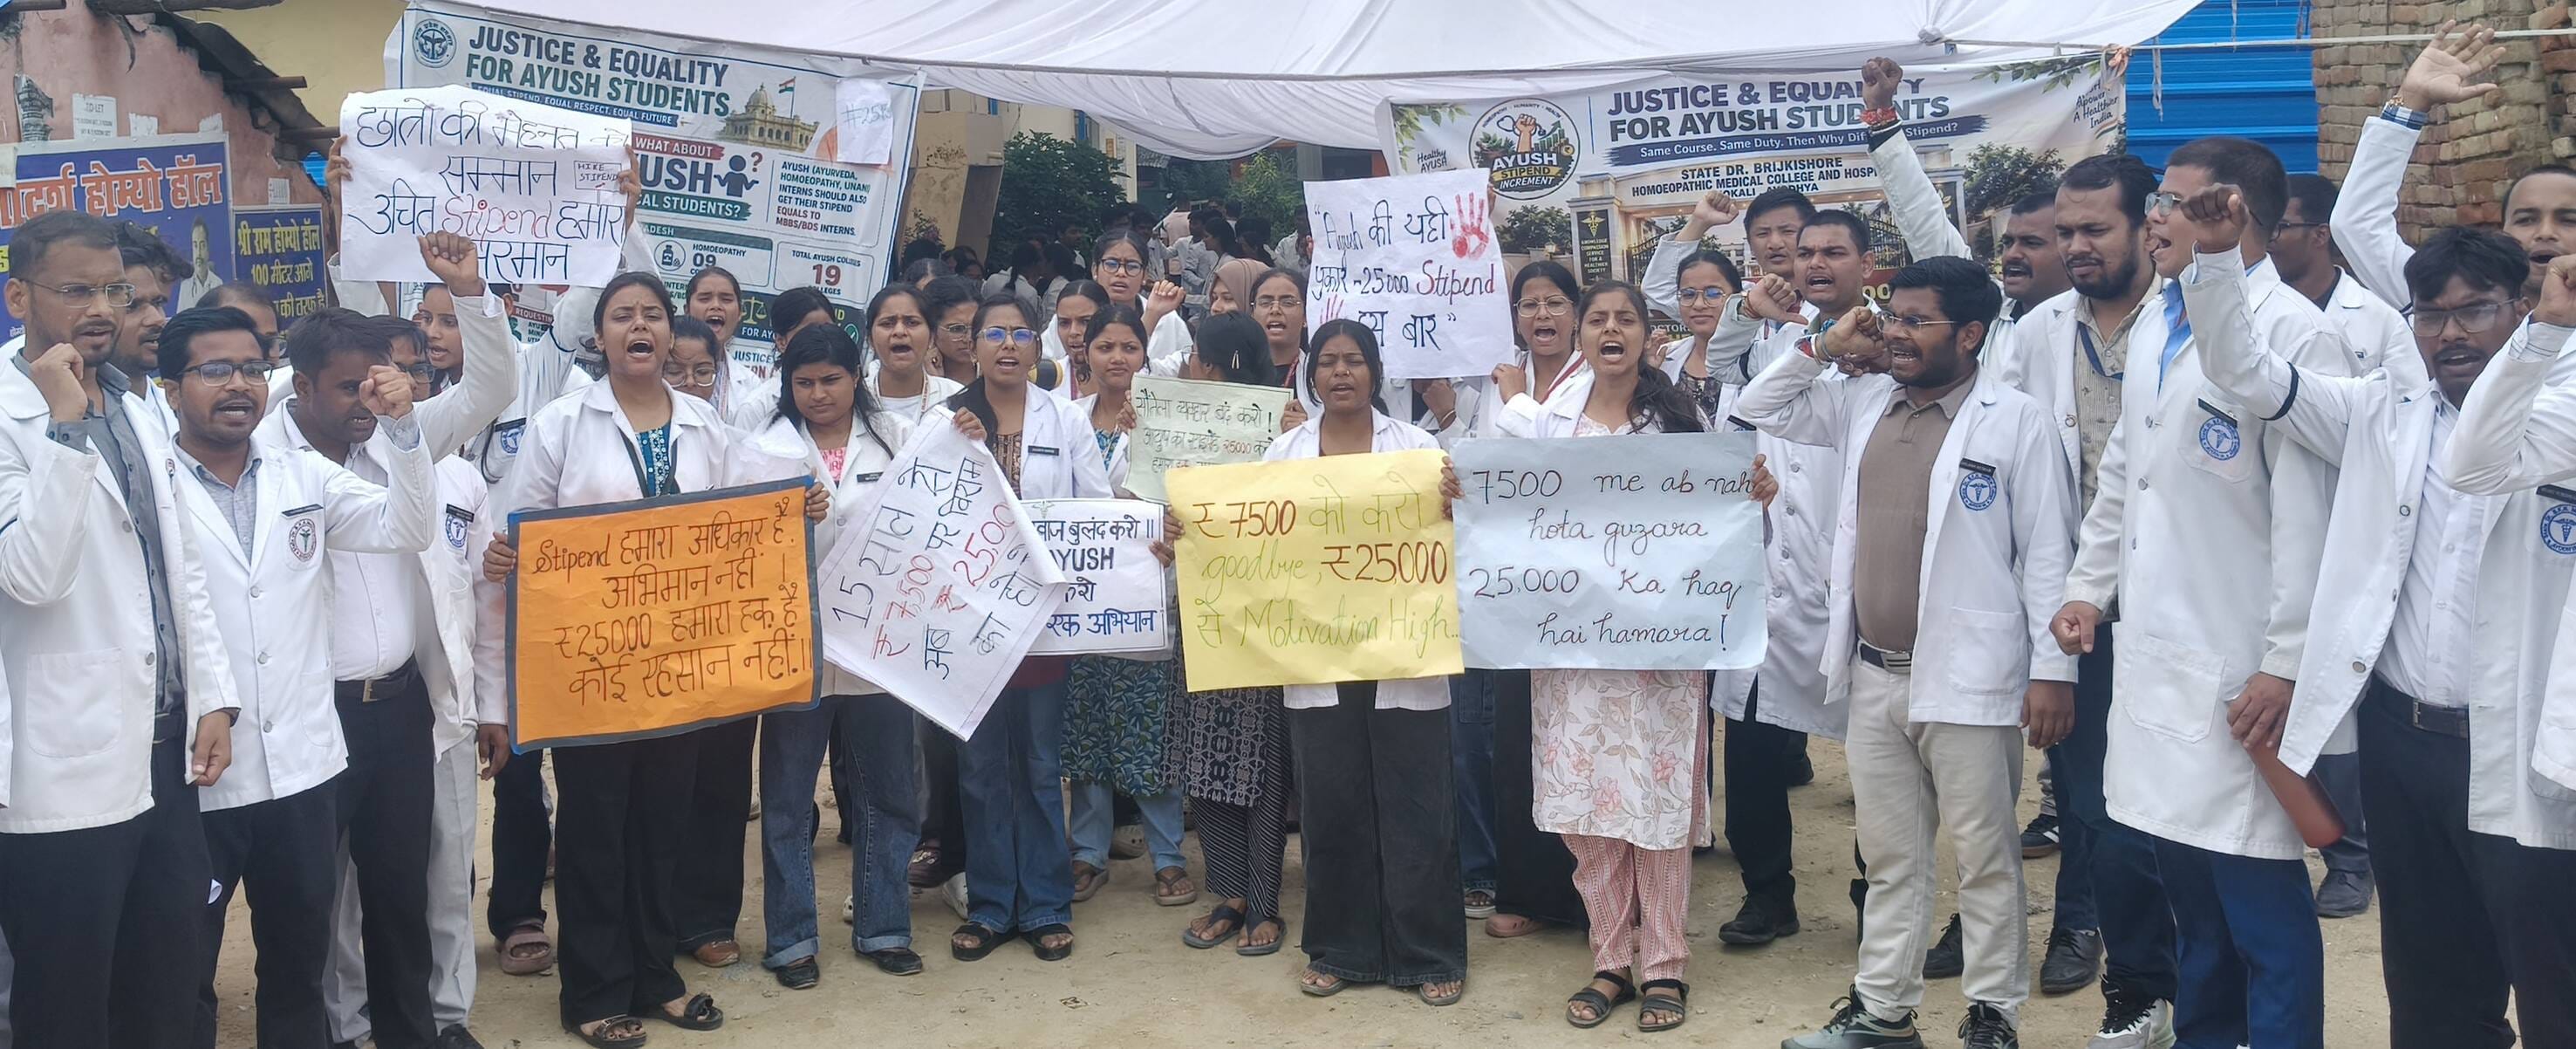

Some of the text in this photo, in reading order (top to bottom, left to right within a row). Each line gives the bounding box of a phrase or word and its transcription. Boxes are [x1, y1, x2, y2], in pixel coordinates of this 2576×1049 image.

[469, 26, 575, 65] JUSTICE
[582, 45, 601, 69] &
[608, 48, 729, 87] EQUALITY
[466, 53, 730, 116] FOR AYUSH STUDENTS
[1608, 84, 1729, 116] JUSTICE
[1737, 82, 1760, 105] &
[441, 100, 489, 145] की
[545, 96, 572, 109] EQUAL
[612, 108, 639, 120] EQUAL
[641, 113, 672, 125] FUTURE
[1609, 96, 1950, 141] FOR AYUSH STUDNTS
[2090, 111, 2113, 128] India
[635, 137, 713, 157] WHAT ABOUT
[1640, 146, 1671, 158] Same
[1673, 142, 1717, 154] Course.
[1719, 139, 1752, 151] Same
[1754, 136, 1784, 150] Duty.
[1787, 135, 1816, 146] Then
[1818, 134, 1845, 147] Why
[1905, 122, 1959, 137] Stipend?
[639, 154, 714, 194] USH
[782, 161, 810, 173] AYUSH
[1421, 158, 1447, 174] AYUSH
[1493, 153, 1558, 170] AYUSH
[1501, 167, 1550, 179] STIPEND
[1681, 157, 1843, 181] STATE DR. BRIJKISHORE
[167, 154, 222, 209] हॉल
[439, 155, 557, 199] सम्मान
[579, 173, 618, 182] STIPEND
[1500, 176, 1554, 189] INCREMENT
[1632, 168, 1841, 197] HOMOEOPATHIC MEDICAL COLLEGE AND
[663, 195, 741, 216] STUDENTS?
[778, 195, 852, 213] GET THEIR STIPEND
[779, 184, 867, 204] INTERNS SHOULD ALSO
[347, 178, 436, 235] उचित
[442, 194, 552, 249] Stipend
[776, 217, 818, 230] MBBS/BDS
[777, 206, 808, 218] EQUALS
[1369, 199, 1392, 247] की
[238, 218, 320, 256] श्री राम होम्यो हॉल
[693, 244, 747, 257] HOMOEOPATHY
[693, 253, 716, 267] 09
[792, 250, 811, 259] TOTAL
[251, 257, 313, 285] 100 मीटर आगे
[813, 264, 841, 286] 19
[1417, 259, 1494, 305] Stipend
[516, 308, 554, 322] REQUESTIN
[742, 327, 759, 336] FOR
[733, 351, 773, 363] JUSTICE
[1472, 470, 1562, 504] 7500
[1594, 473, 1644, 493] me
[1661, 469, 1694, 493] ab
[1308, 475, 1350, 535] को
[1362, 470, 1421, 533] करो
[858, 504, 915, 576] साल
[925, 521, 960, 551] पर
[1068, 517, 1109, 545] बुलंद
[1110, 514, 1140, 540] करो
[1528, 507, 1709, 567] hota guzara
[532, 532, 611, 584] Stipend
[620, 525, 680, 565] हमारा
[688, 511, 769, 555] अधिकार
[602, 547, 764, 609] अभिमान नहीं
[1683, 569, 1742, 609] haq
[670, 600, 732, 641] हमारा
[778, 582, 799, 628] है
[1087, 607, 1157, 635] अभियान
[1194, 599, 1226, 648] से
[1240, 594, 1378, 648] Motivation
[1537, 612, 1588, 645] hai
[924, 623, 954, 681] अब
[569, 655, 630, 706] कोई
